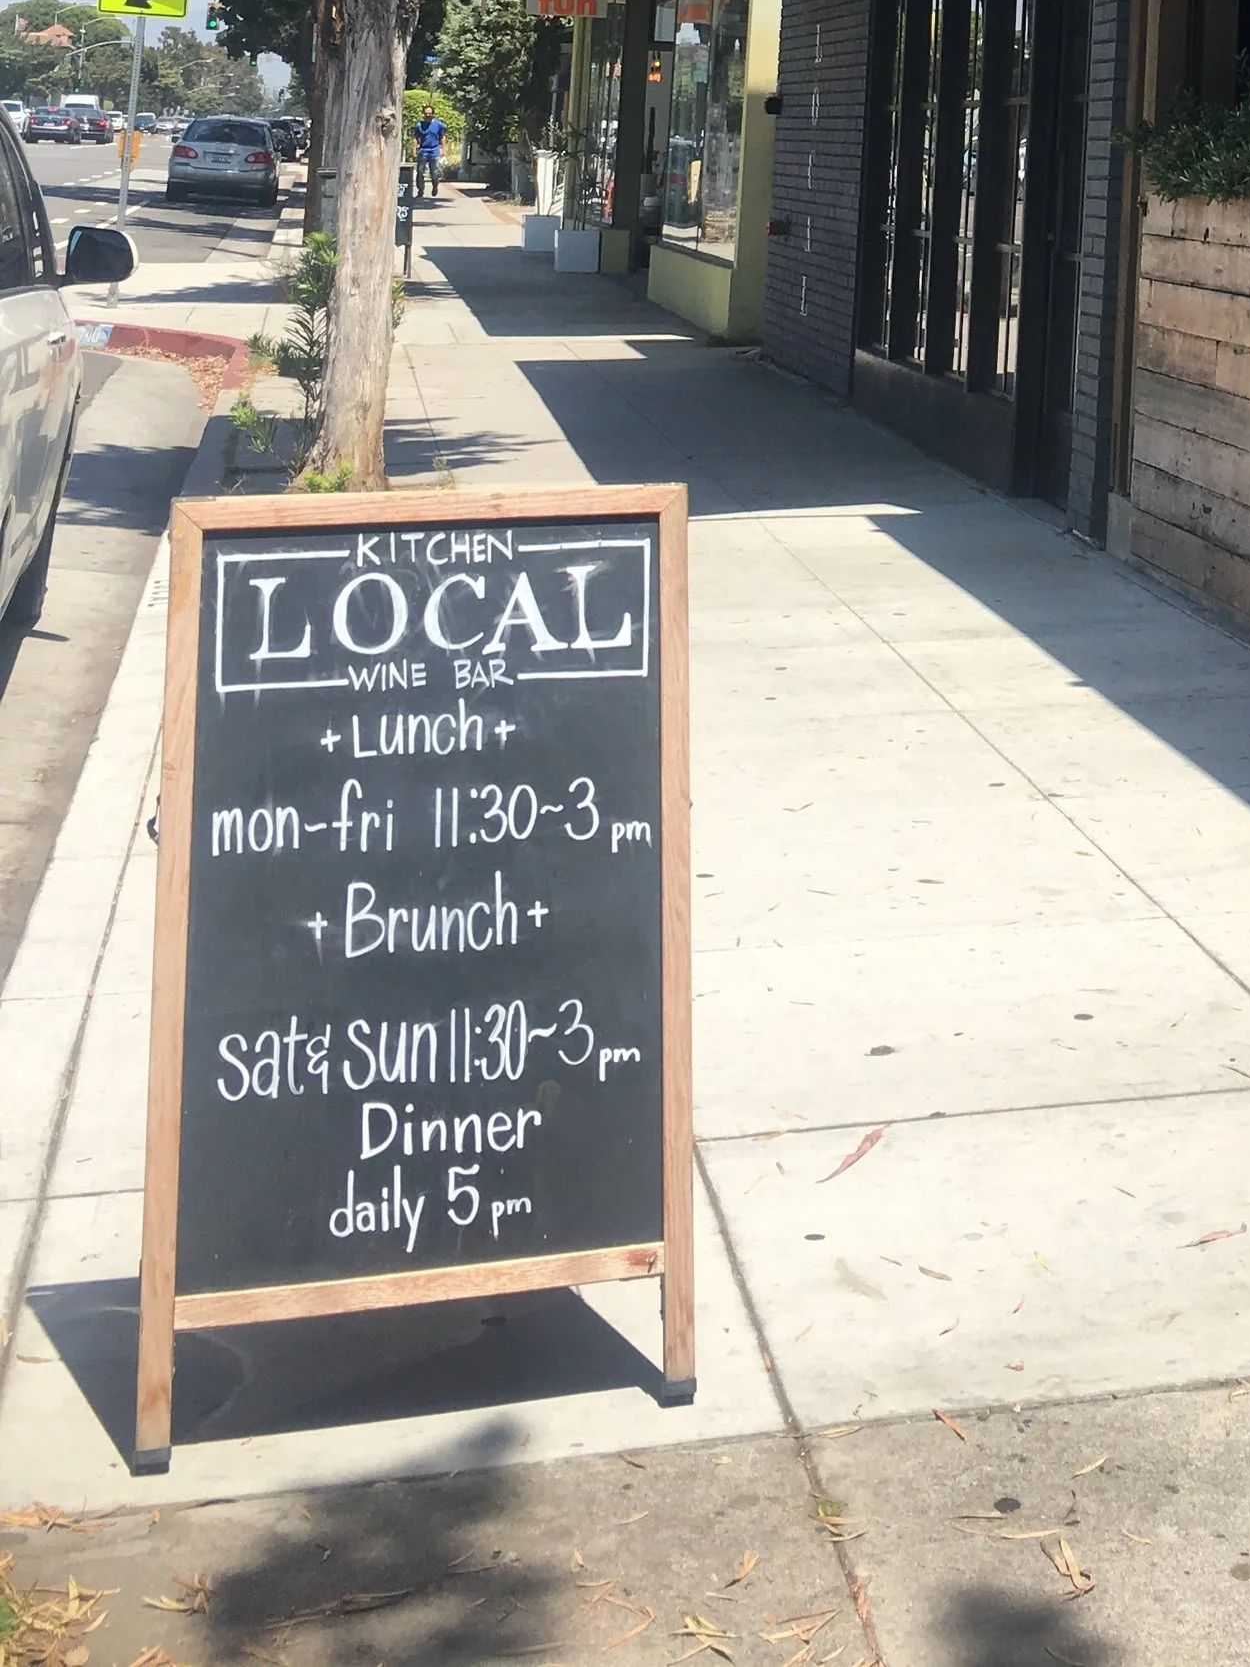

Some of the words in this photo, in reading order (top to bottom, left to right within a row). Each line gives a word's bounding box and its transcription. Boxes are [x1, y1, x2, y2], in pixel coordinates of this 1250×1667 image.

[355, 530, 514, 567] KITCHEN
[248, 565, 633, 661] LOCAL
[348, 661, 428, 693] WINE
[454, 658, 516, 688] BAR
[359, 1100, 543, 1160] Dinner
[328, 1165, 427, 1254] daily
[446, 1163, 481, 1227] 5
[490, 1193, 533, 1240] pm
